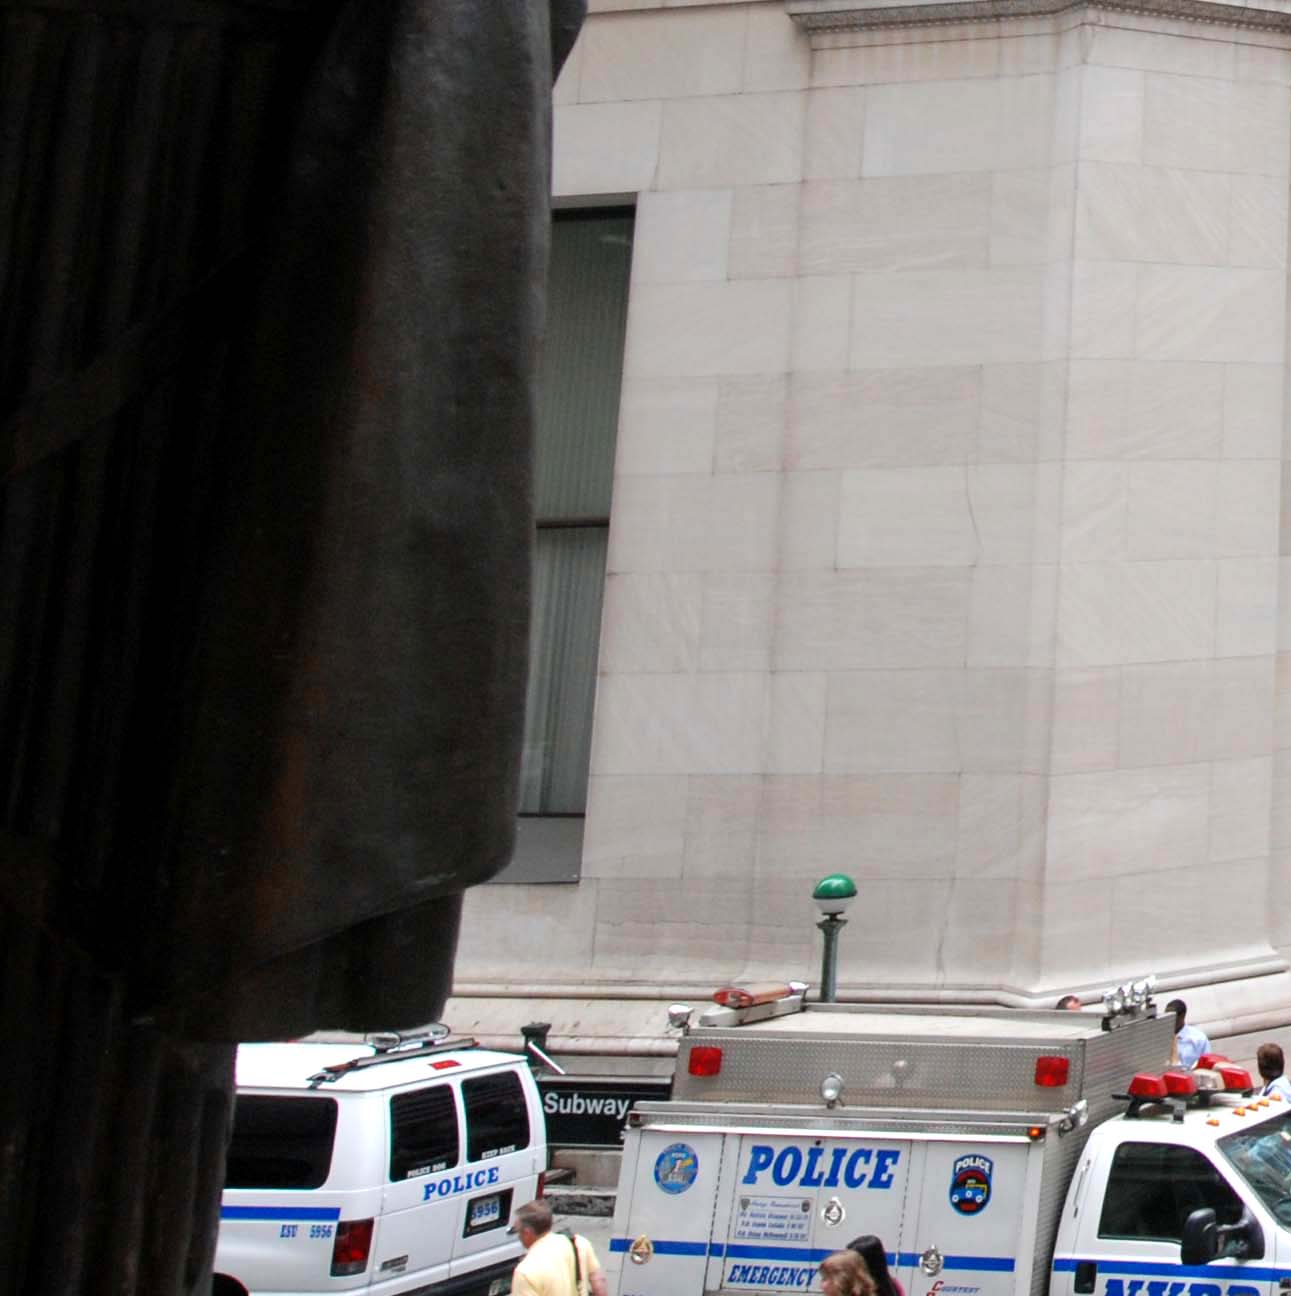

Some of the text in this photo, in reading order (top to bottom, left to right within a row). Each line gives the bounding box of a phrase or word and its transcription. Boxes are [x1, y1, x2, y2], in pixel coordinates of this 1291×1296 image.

[544, 1092, 630, 1120] Subway
[742, 1145, 901, 1189] POLICE
[955, 1156, 991, 1174] POLICE
[423, 1166, 500, 1201] POLICE
[309, 1224, 332, 1238] 5956
[727, 1264, 819, 1287] EMERGENCY
